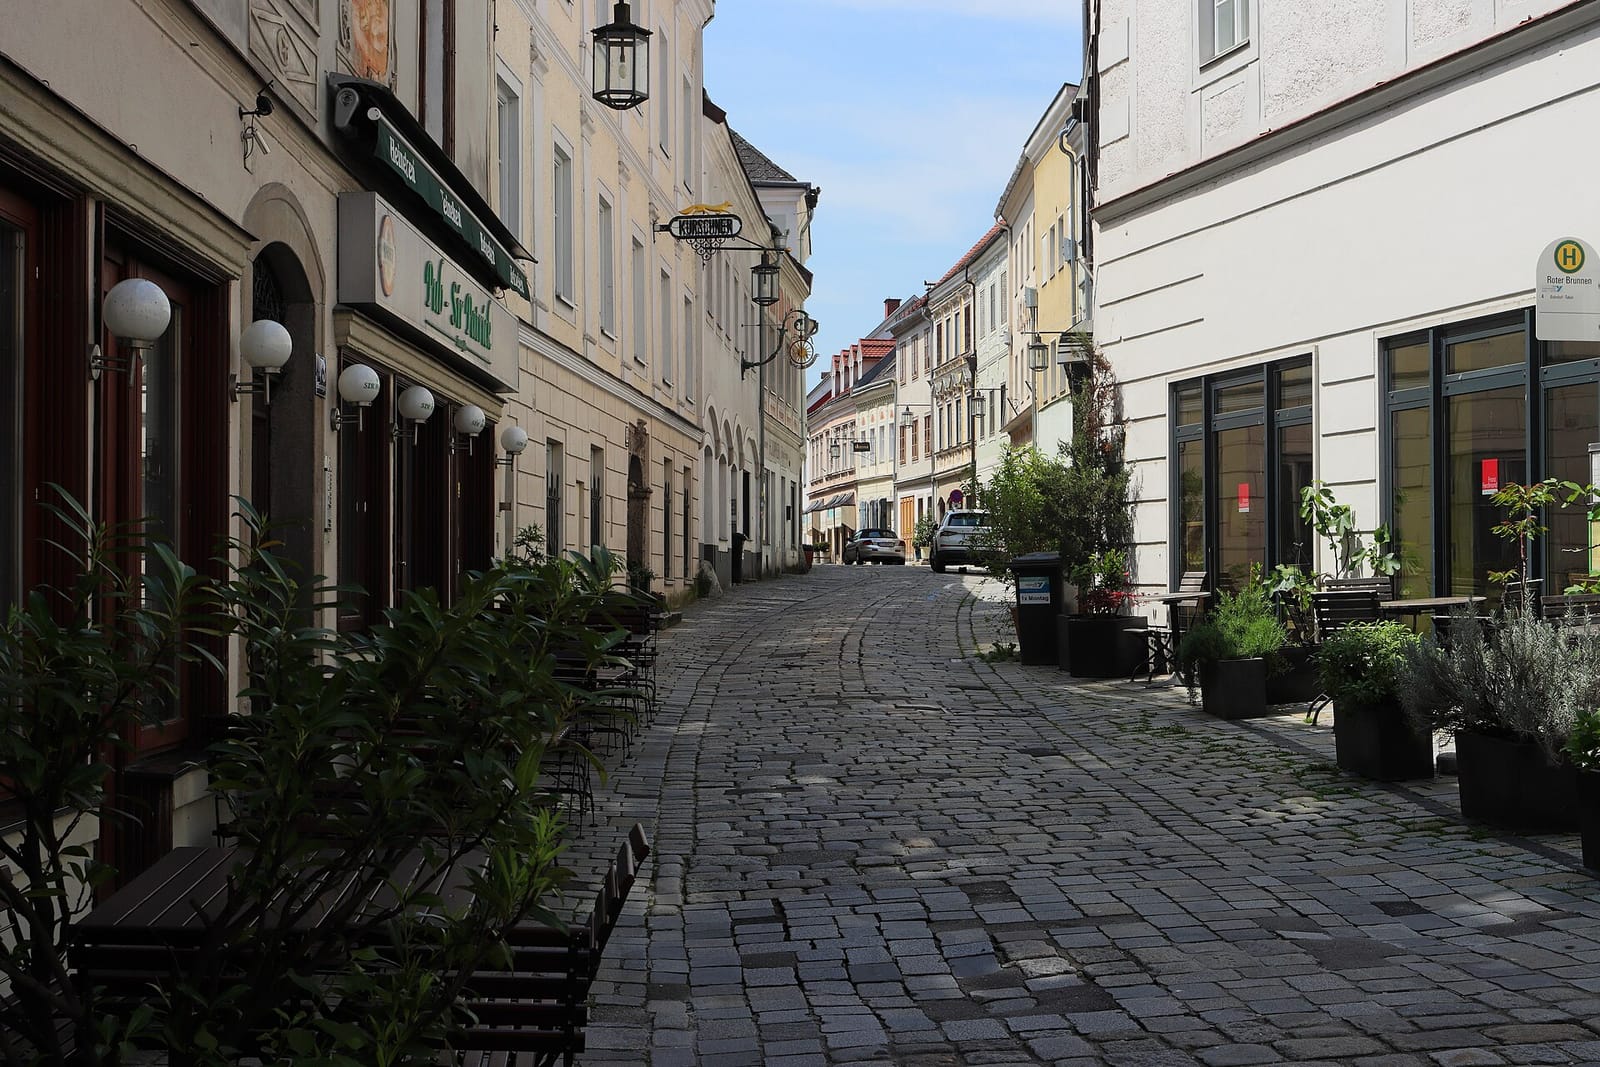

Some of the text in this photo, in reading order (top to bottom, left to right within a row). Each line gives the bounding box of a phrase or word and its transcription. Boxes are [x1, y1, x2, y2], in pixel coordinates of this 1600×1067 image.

[389, 135, 417, 184] Heineken
[1563, 247, 1576, 266] H
[424, 258, 445, 315] Pub
[450, 281, 465, 329] Sir
[1546, 275, 1592, 285] Roter Brunnen
